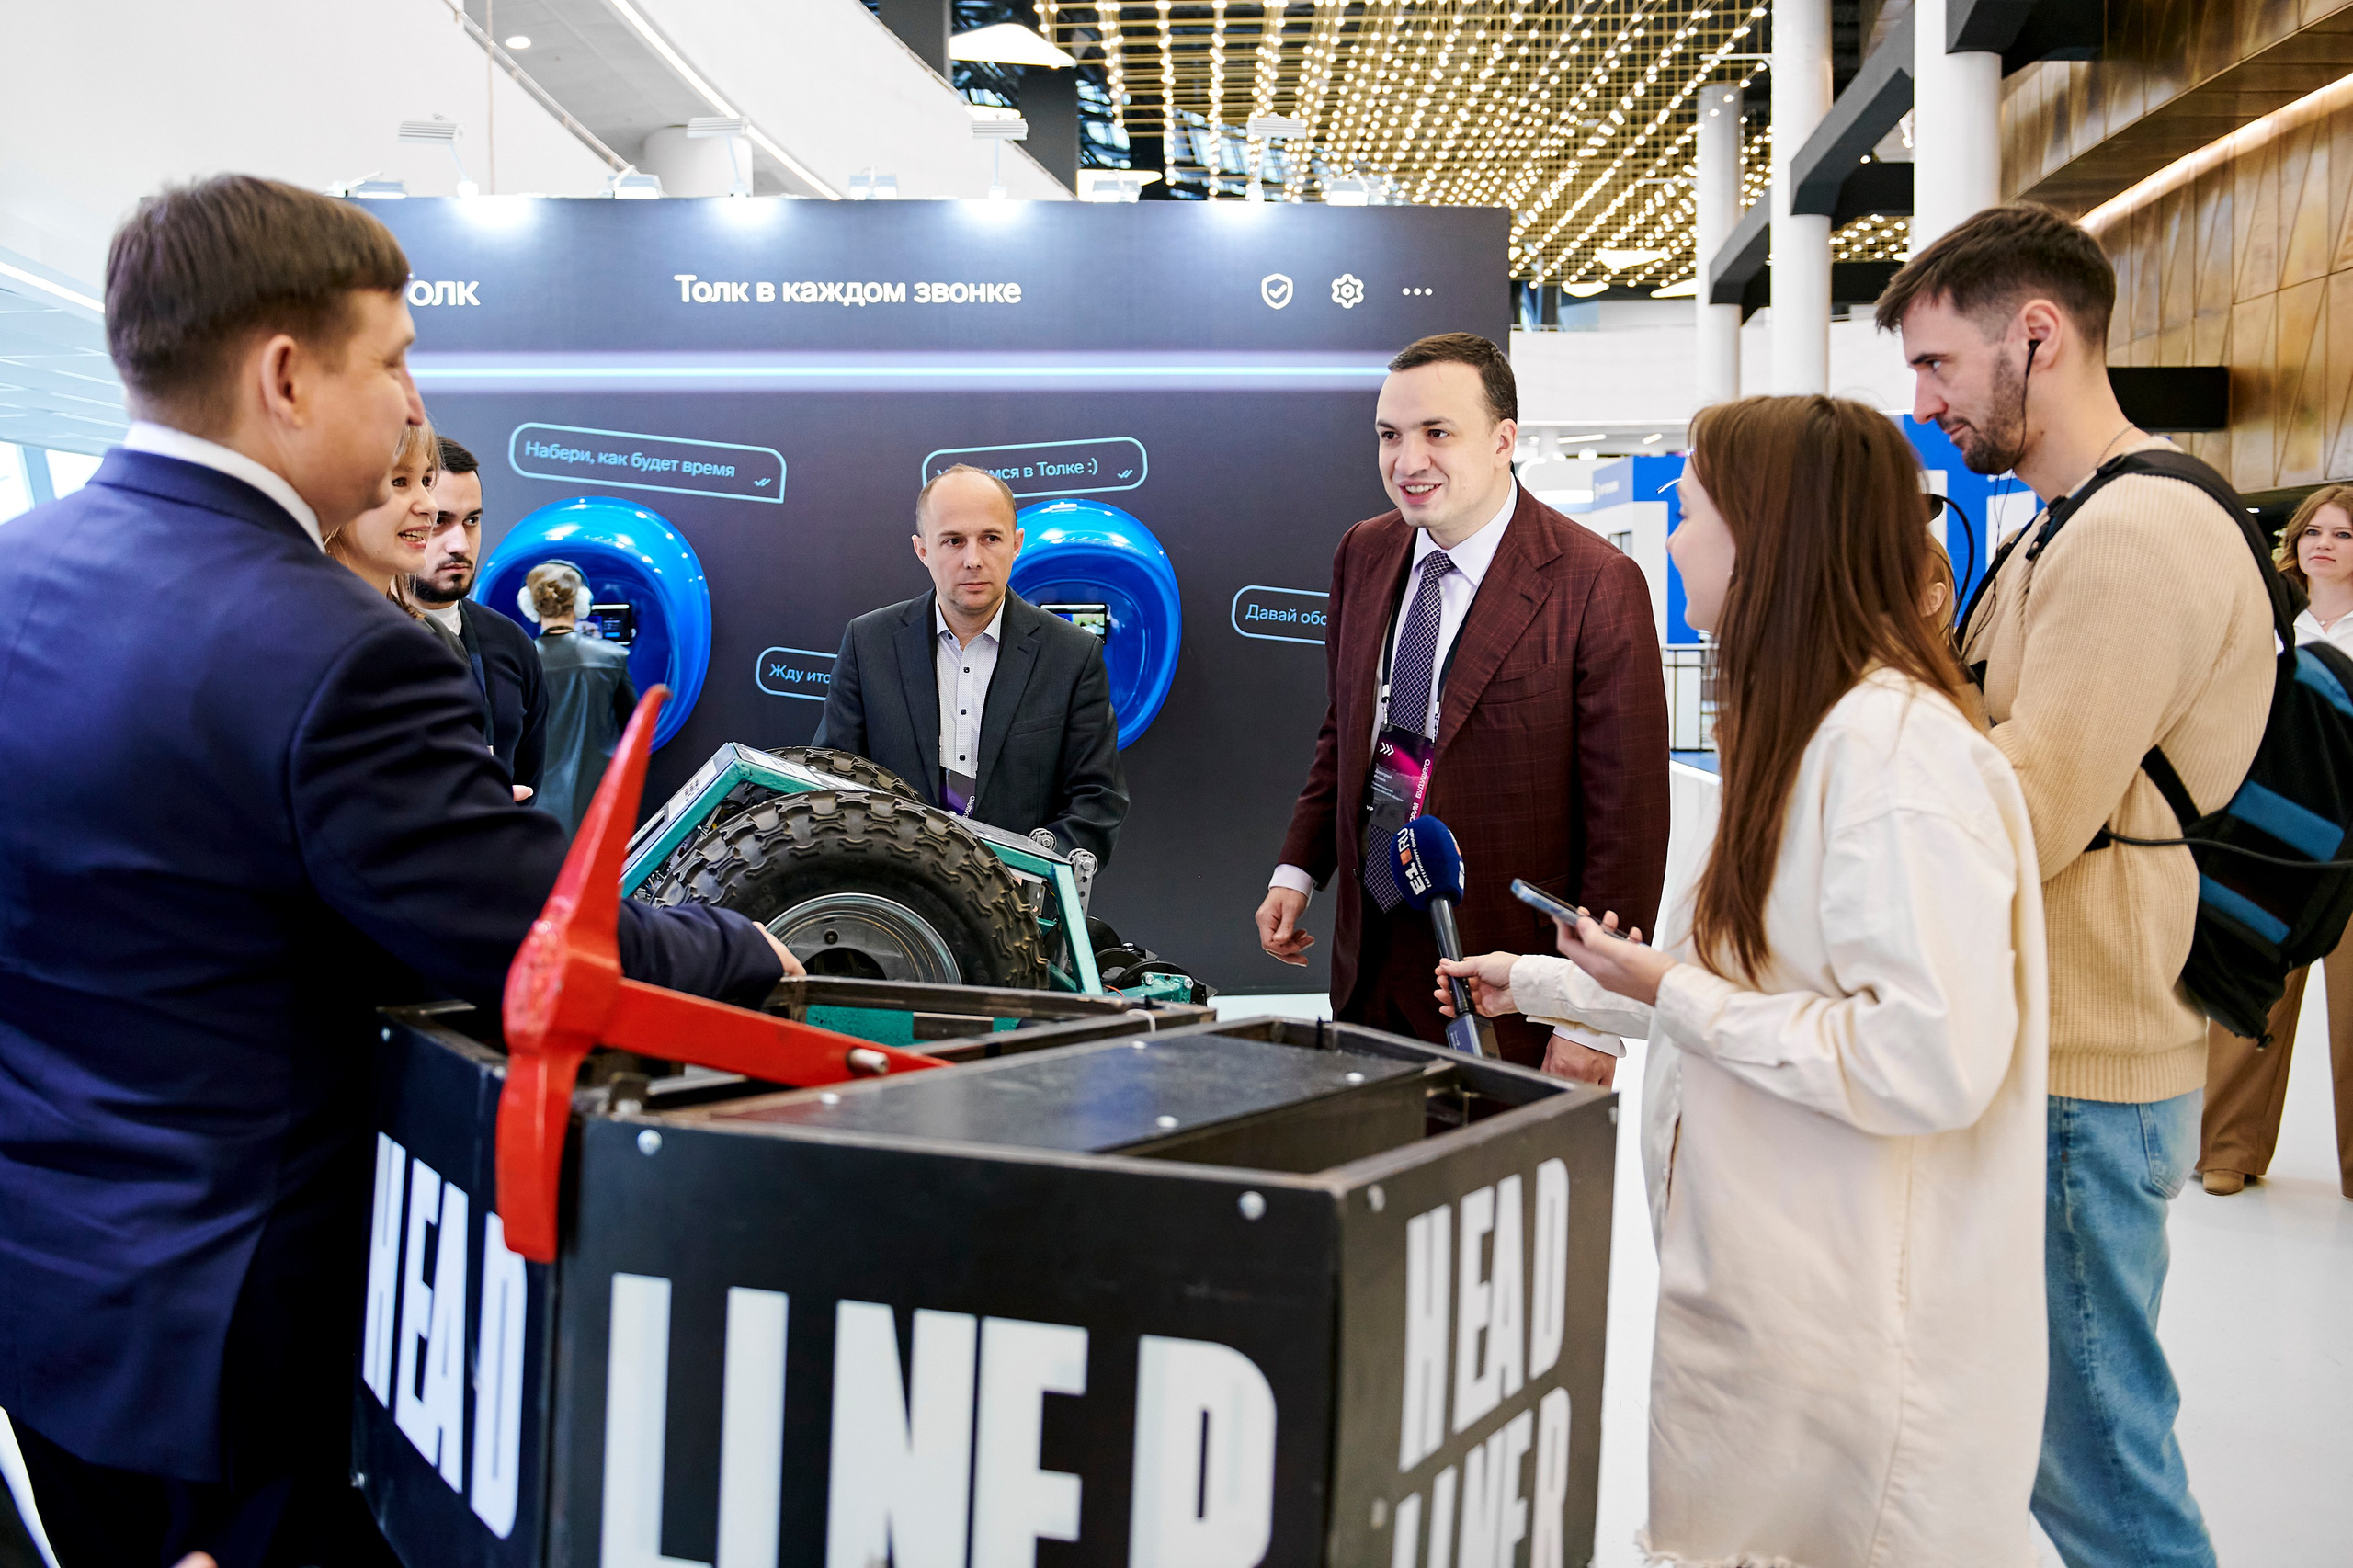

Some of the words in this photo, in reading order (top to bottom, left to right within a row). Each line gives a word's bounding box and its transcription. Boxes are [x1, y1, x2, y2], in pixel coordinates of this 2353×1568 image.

[405, 277, 481, 307] олк
[673, 274, 750, 303] Толк
[756, 281, 776, 303] в
[782, 281, 906, 307] каждом
[913, 281, 1022, 304] звонке
[525, 440, 595, 464] Набери,
[597, 450, 628, 467] как
[631, 452, 680, 472] будет
[682, 460, 736, 477] время
[1023, 466, 1033, 477] в
[1036, 460, 1085, 477] Толке
[1245, 603, 1297, 623] Давай
[769, 663, 804, 683] Жду
[1398, 1157, 1570, 1473] HEAD
[362, 1131, 528, 1540] HEAD
